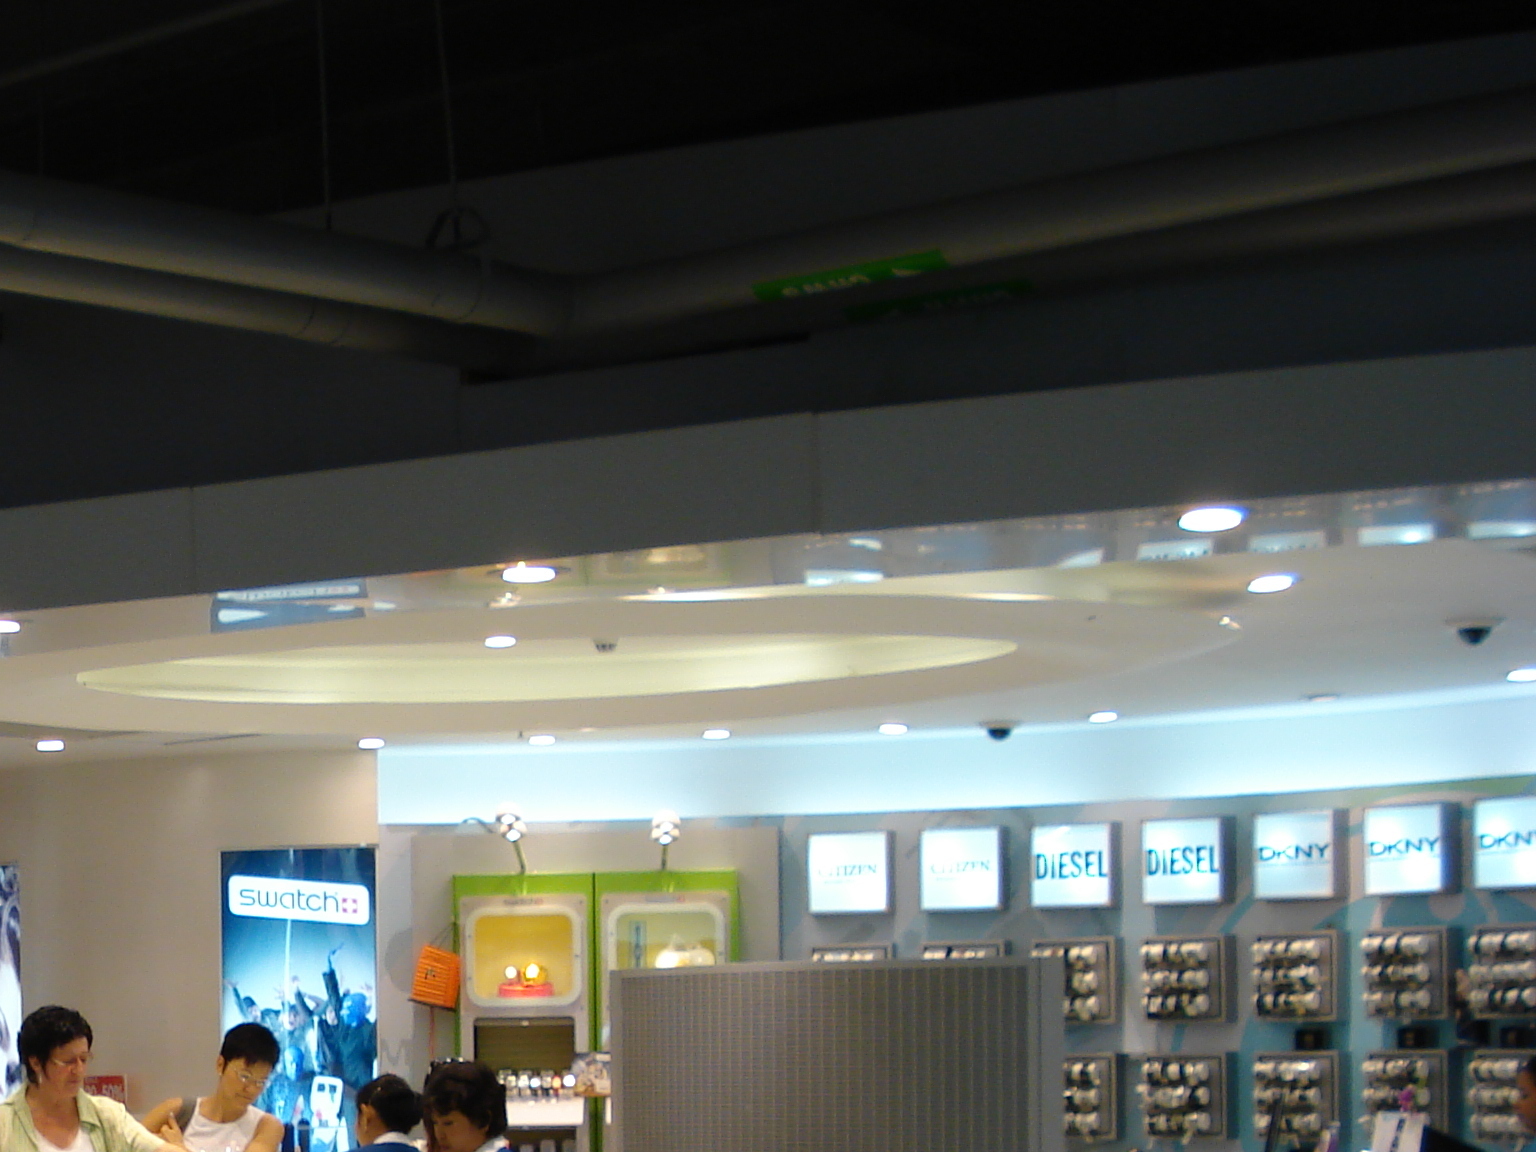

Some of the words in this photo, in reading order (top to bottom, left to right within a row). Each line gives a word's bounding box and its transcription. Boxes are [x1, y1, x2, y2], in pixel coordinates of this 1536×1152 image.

[1258, 843, 1330, 861] DKNY
[1369, 837, 1440, 856] DKNY
[1035, 851, 1108, 880] DIESEL
[1146, 845, 1220, 876] DIESEL
[239, 888, 339, 913] swatch
